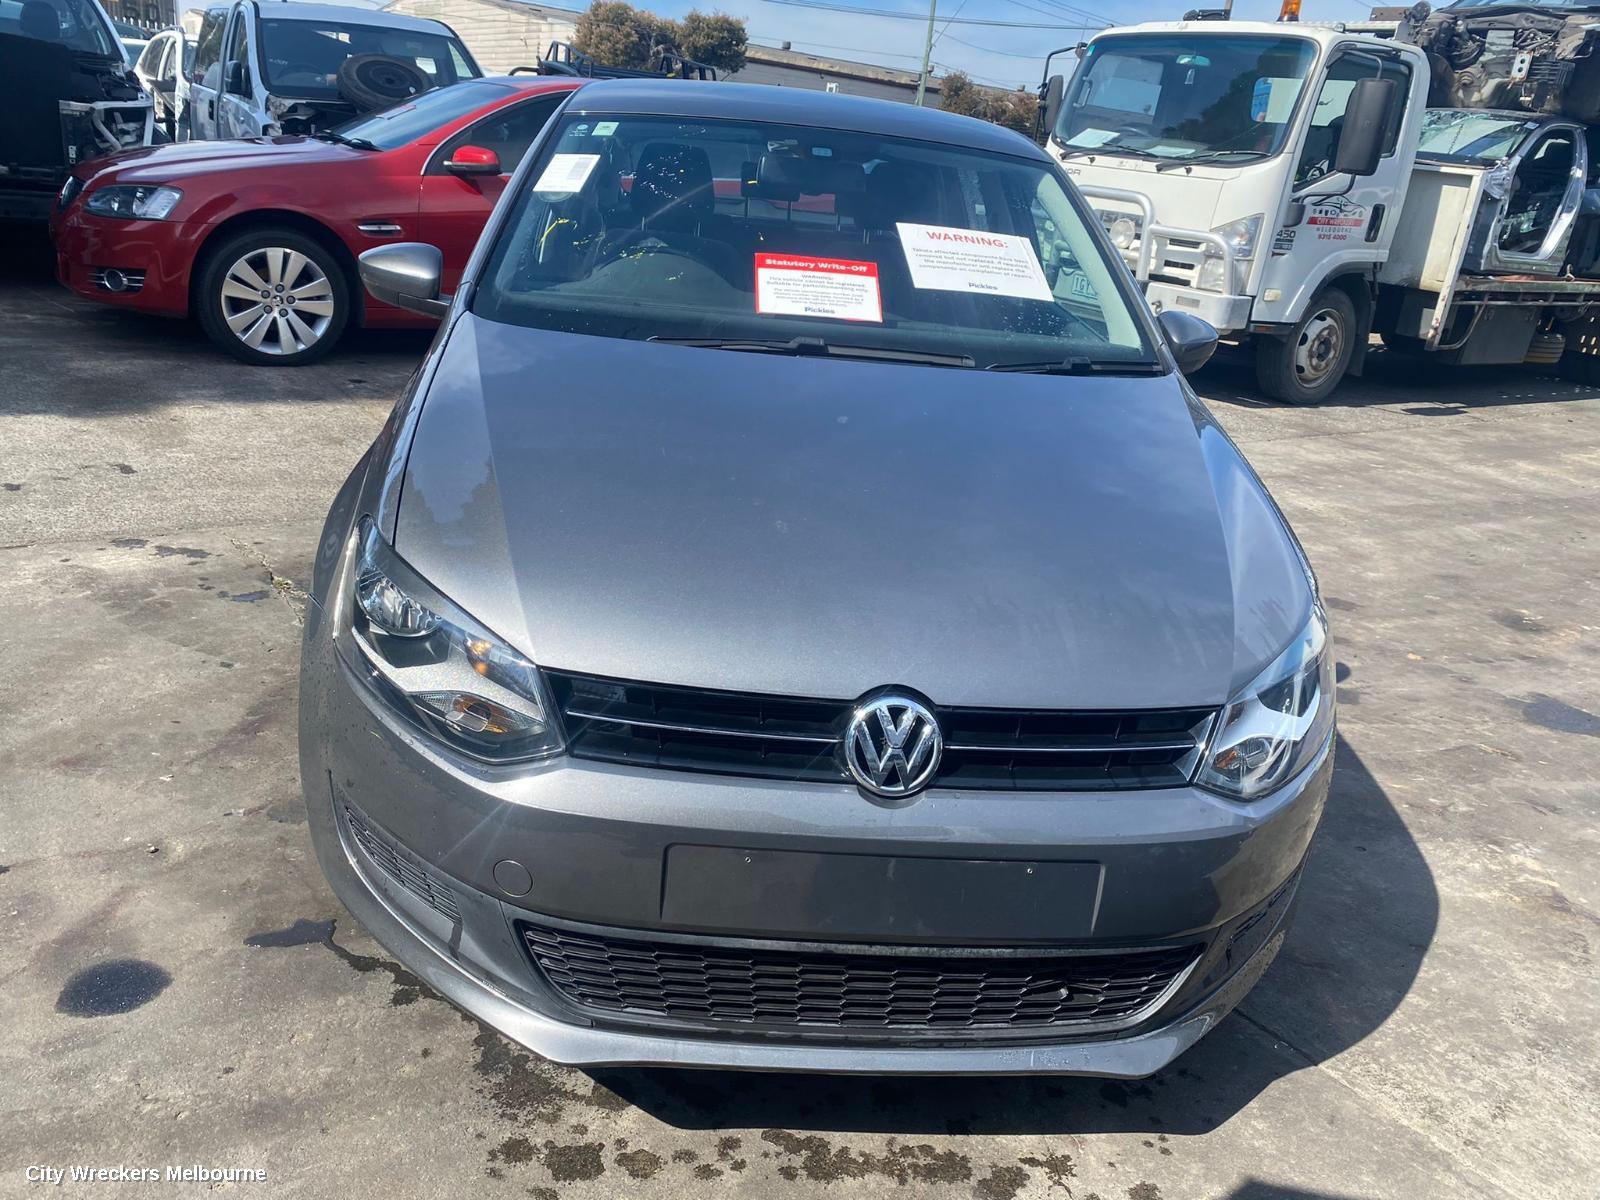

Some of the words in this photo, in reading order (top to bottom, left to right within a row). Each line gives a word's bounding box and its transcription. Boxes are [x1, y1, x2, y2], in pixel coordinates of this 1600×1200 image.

[1276, 230, 1296, 238] 450
[926, 231, 1008, 248] WARNING:
[765, 258, 815, 269] Statutory
[818, 262, 868, 272] Write-Off
[968, 282, 998, 290] Pickles
[804, 306, 835, 314] Pickles
